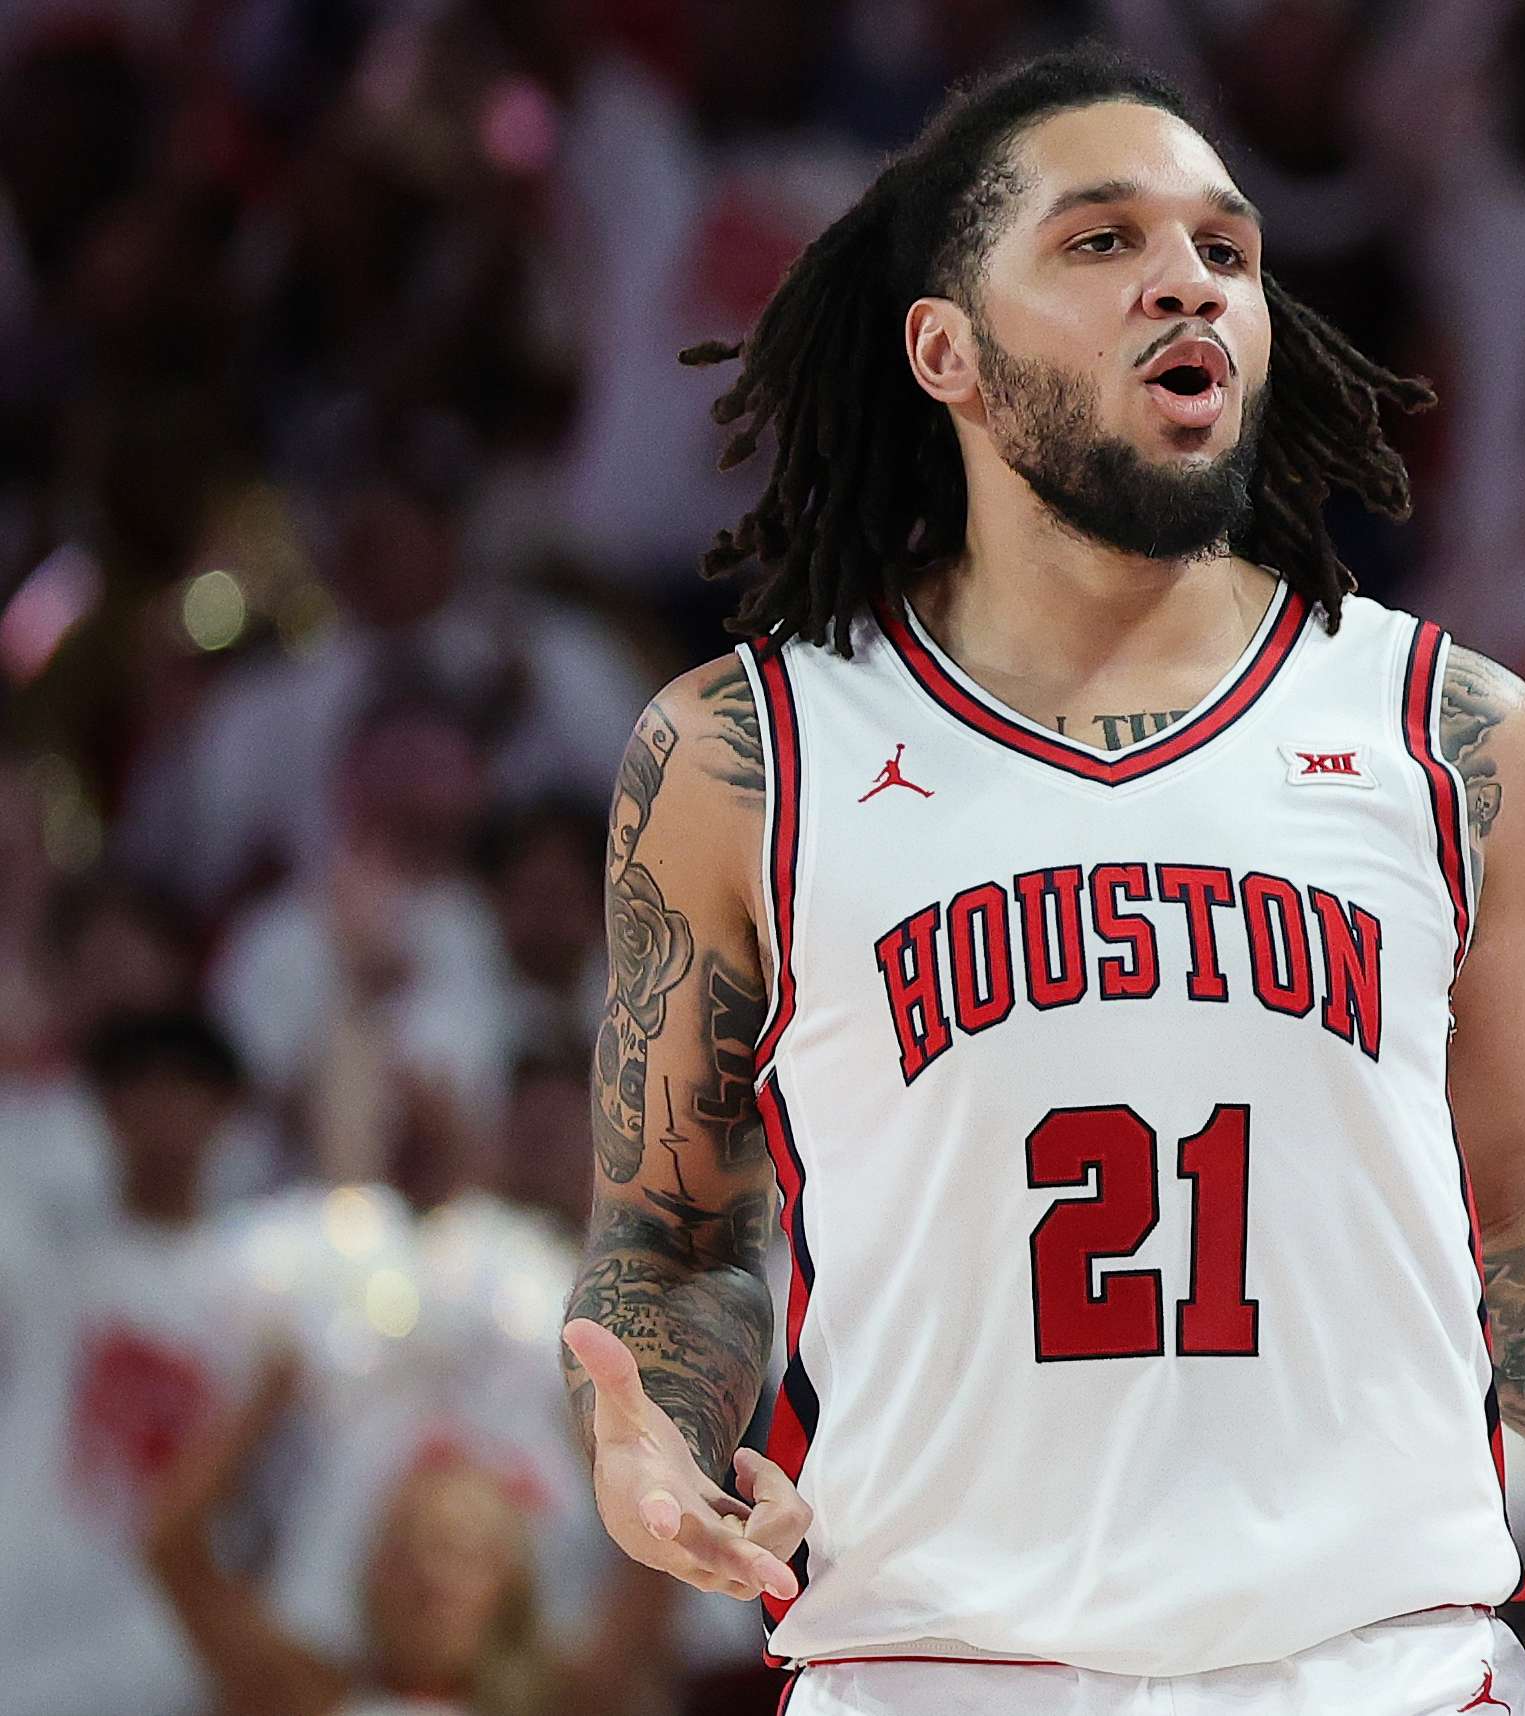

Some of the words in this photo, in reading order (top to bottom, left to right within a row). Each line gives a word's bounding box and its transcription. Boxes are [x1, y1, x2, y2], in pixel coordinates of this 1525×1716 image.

[1295, 751, 1362, 776] XII
[874, 863, 1383, 1087] HOUSTON
[1025, 1103, 1259, 1363] 21
